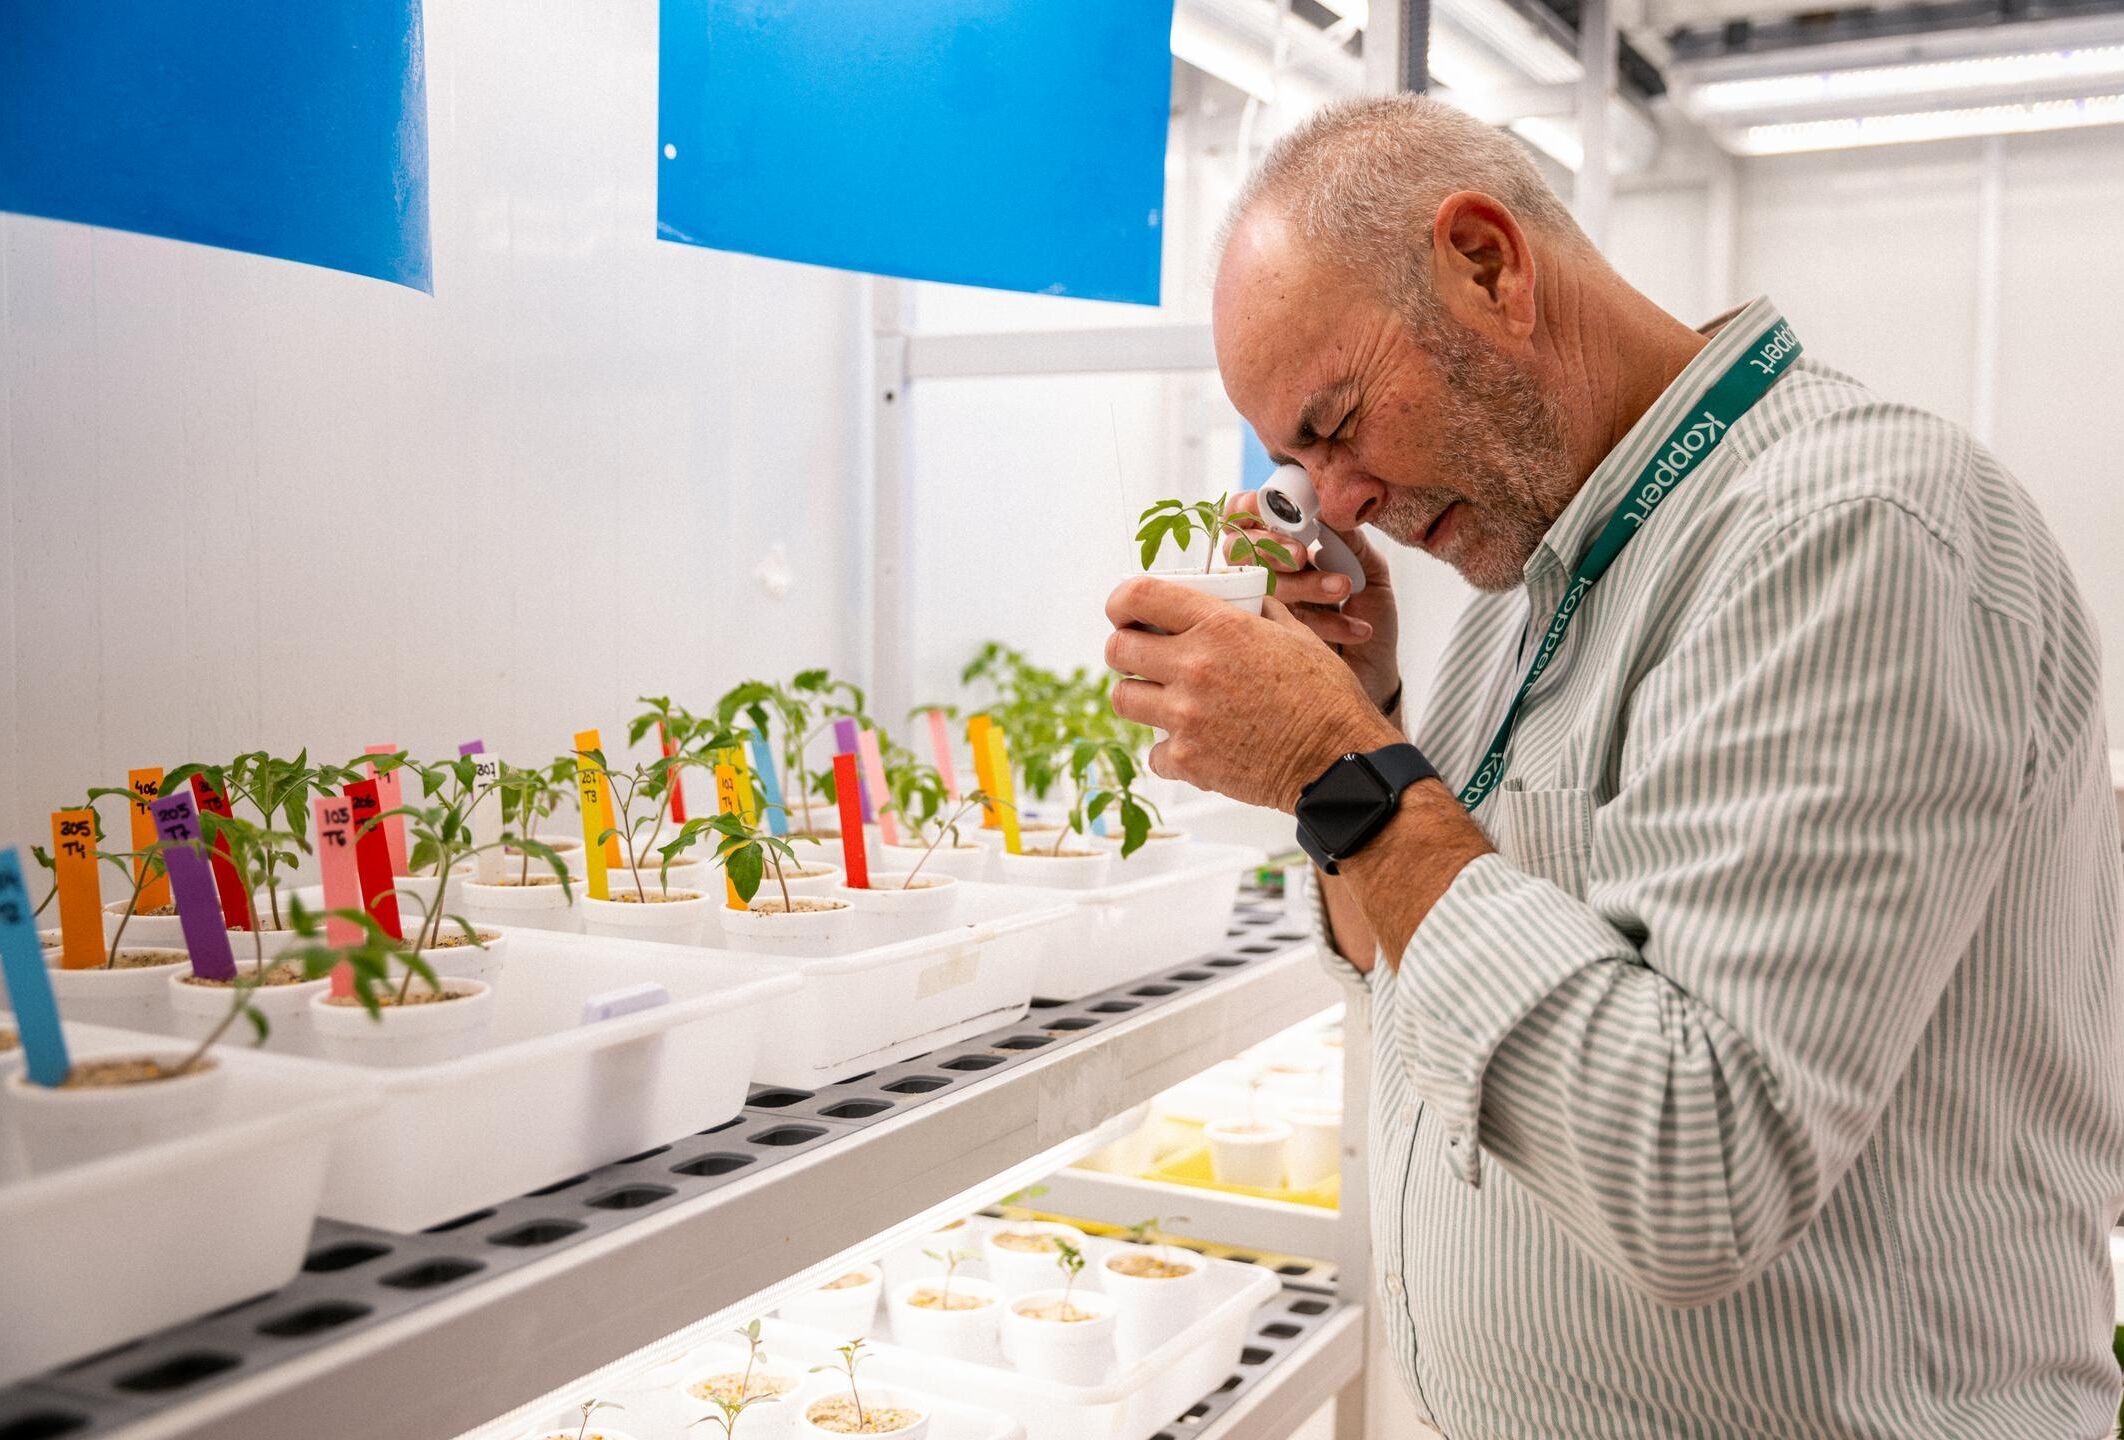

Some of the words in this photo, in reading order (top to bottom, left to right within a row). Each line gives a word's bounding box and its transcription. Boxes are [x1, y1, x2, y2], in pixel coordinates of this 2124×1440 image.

[1623, 411, 1726, 527] Koppert
[135, 780, 158, 796] 406
[1463, 753, 1503, 808] Kop
[158, 802, 191, 822] 205
[164, 823, 191, 841] T7
[322, 830, 347, 847] T6
[62, 841, 86, 859] T4
